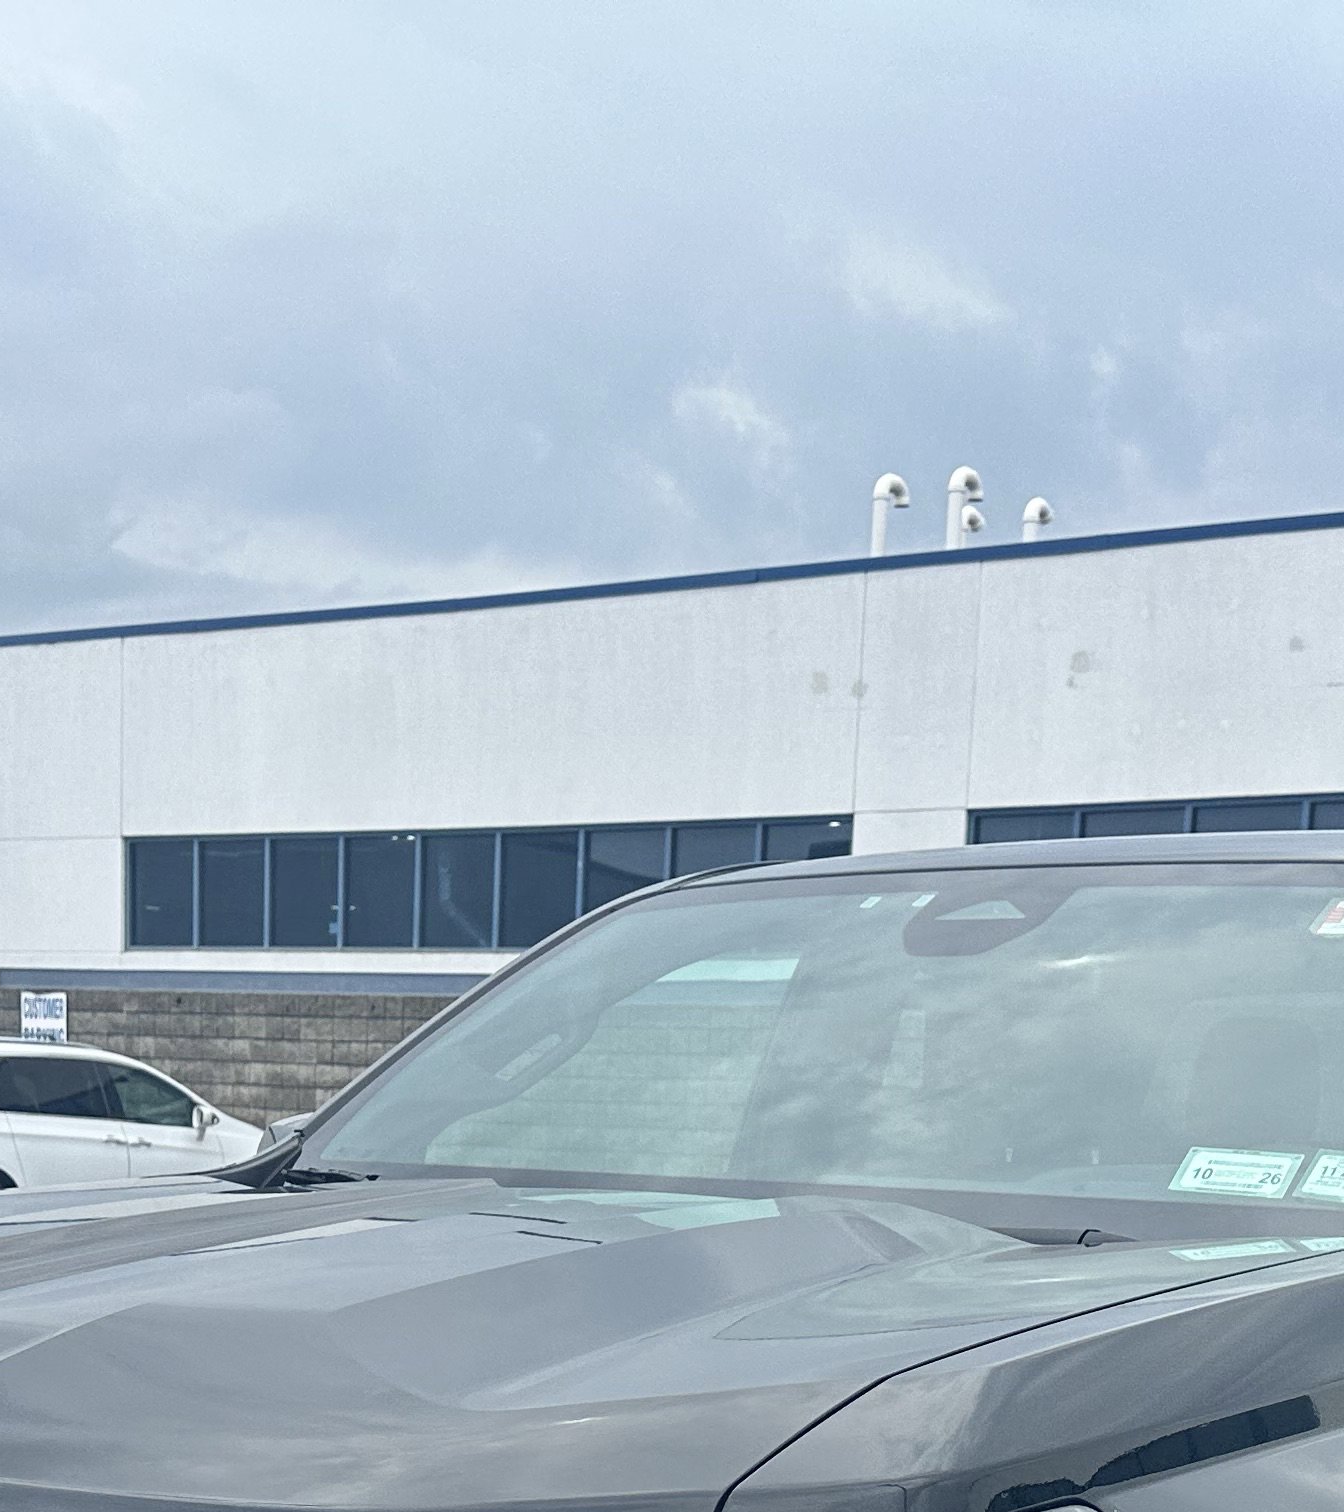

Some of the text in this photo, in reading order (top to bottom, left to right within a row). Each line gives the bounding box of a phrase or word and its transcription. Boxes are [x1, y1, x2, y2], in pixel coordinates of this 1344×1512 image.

[24, 997, 64, 1019] CUSTOMER
[1191, 1167, 1214, 1180] 10
[1258, 1172, 1282, 1185] 26
[1321, 1165, 1337, 1177] 11
